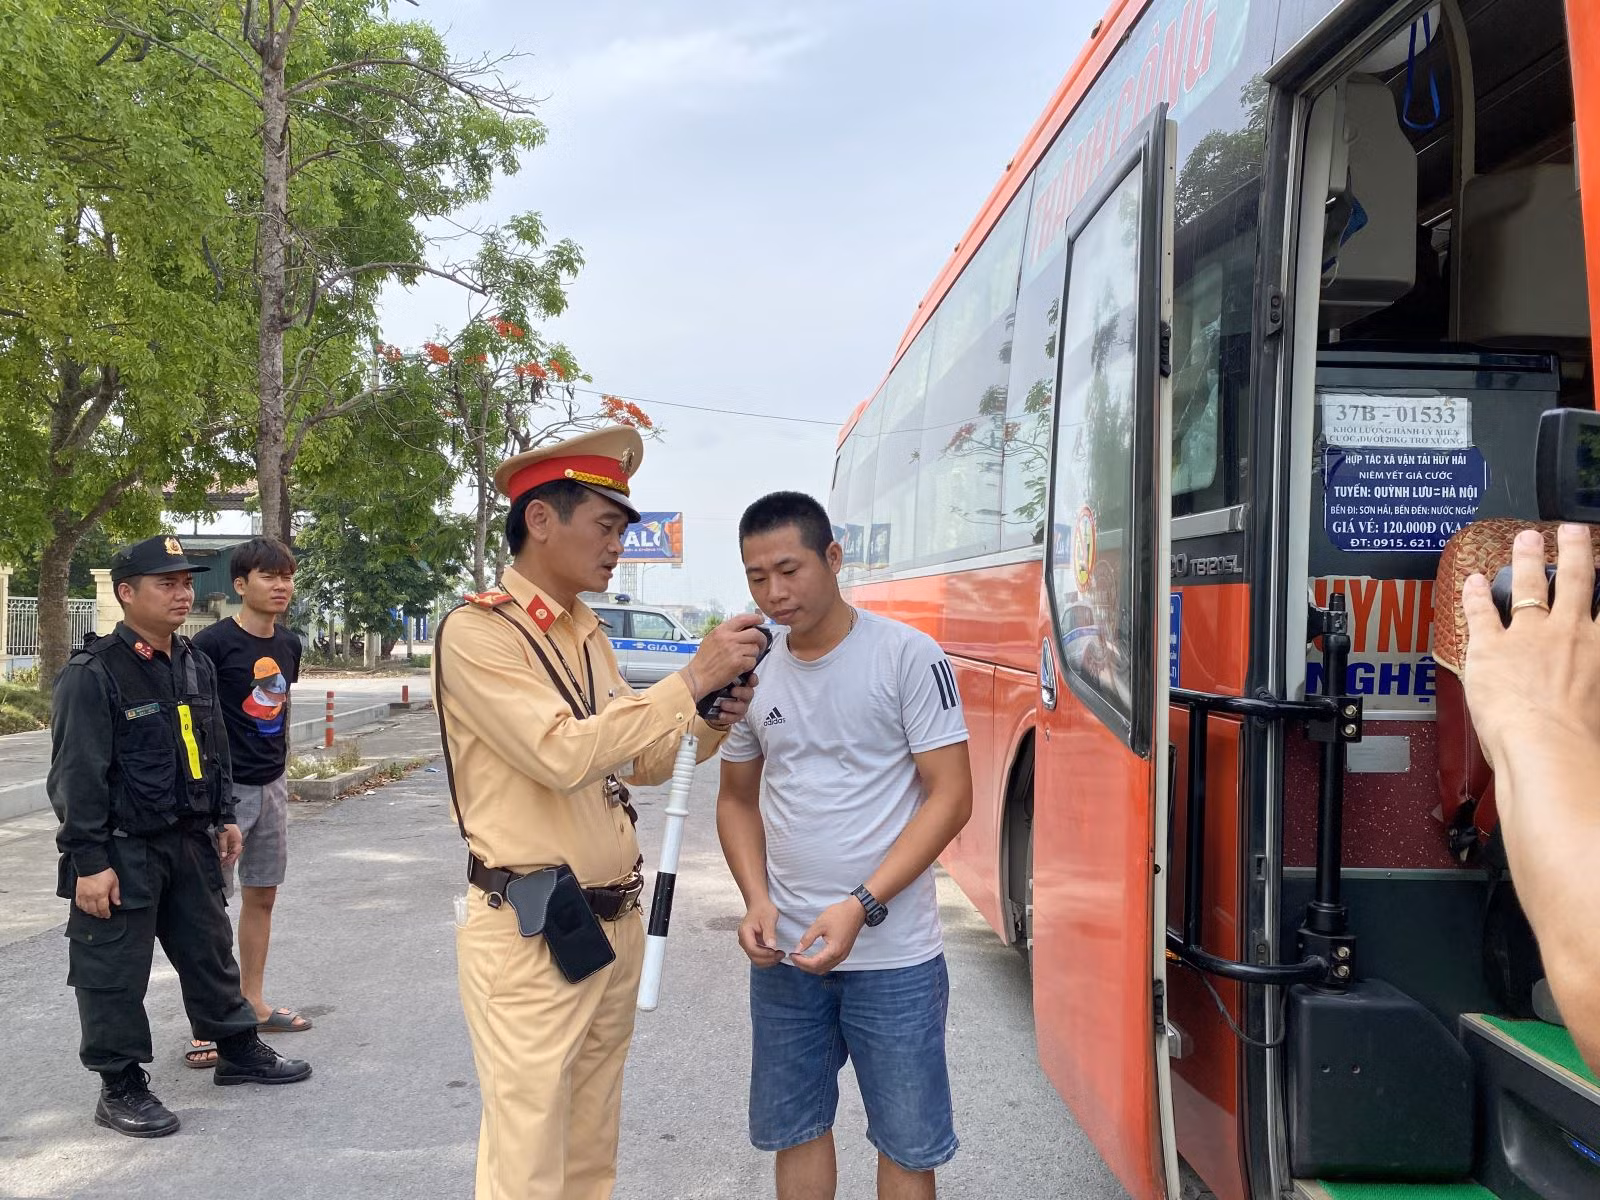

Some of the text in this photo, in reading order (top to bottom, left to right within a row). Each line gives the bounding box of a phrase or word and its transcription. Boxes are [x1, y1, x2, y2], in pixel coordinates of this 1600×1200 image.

[1108, 0, 1217, 161] CÔNG
[1336, 404, 1376, 421] 37B
[1396, 406, 1457, 424] 01533
[1365, 453, 1381, 465] TÁC
[1383, 453, 1396, 465] XÃ
[1397, 453, 1415, 467] VẬN
[1417, 452, 1431, 465] TẢI
[1451, 452, 1467, 465] HẢI
[1359, 469, 1453, 480] NIÊM YẾT GIÁ CƯỚC
[1334, 483, 1478, 501] TUYẾN: QUỲNH LƯU HÀ NỘI
[1330, 503, 1346, 515] BẾN
[1347, 505, 1358, 515] ĐI:
[1359, 505, 1376, 515] SƠN
[1377, 503, 1393, 516] HẢI,
[1394, 503, 1410, 515] BẾN
[1411, 504, 1430, 515] ĐẾN:
[1431, 504, 1454, 515] NƯỚC
[1332, 517, 1355, 534] GIÁ
[1358, 517, 1379, 534] VÉ:
[1383, 521, 1437, 534] 120.000Đ
[1350, 538, 1371, 547] ĐT:
[1373, 538, 1407, 548] 0915.
[1409, 538, 1436, 548] 621.
[647, 643, 678, 652] GIAO
[763, 717, 786, 727] adidas
